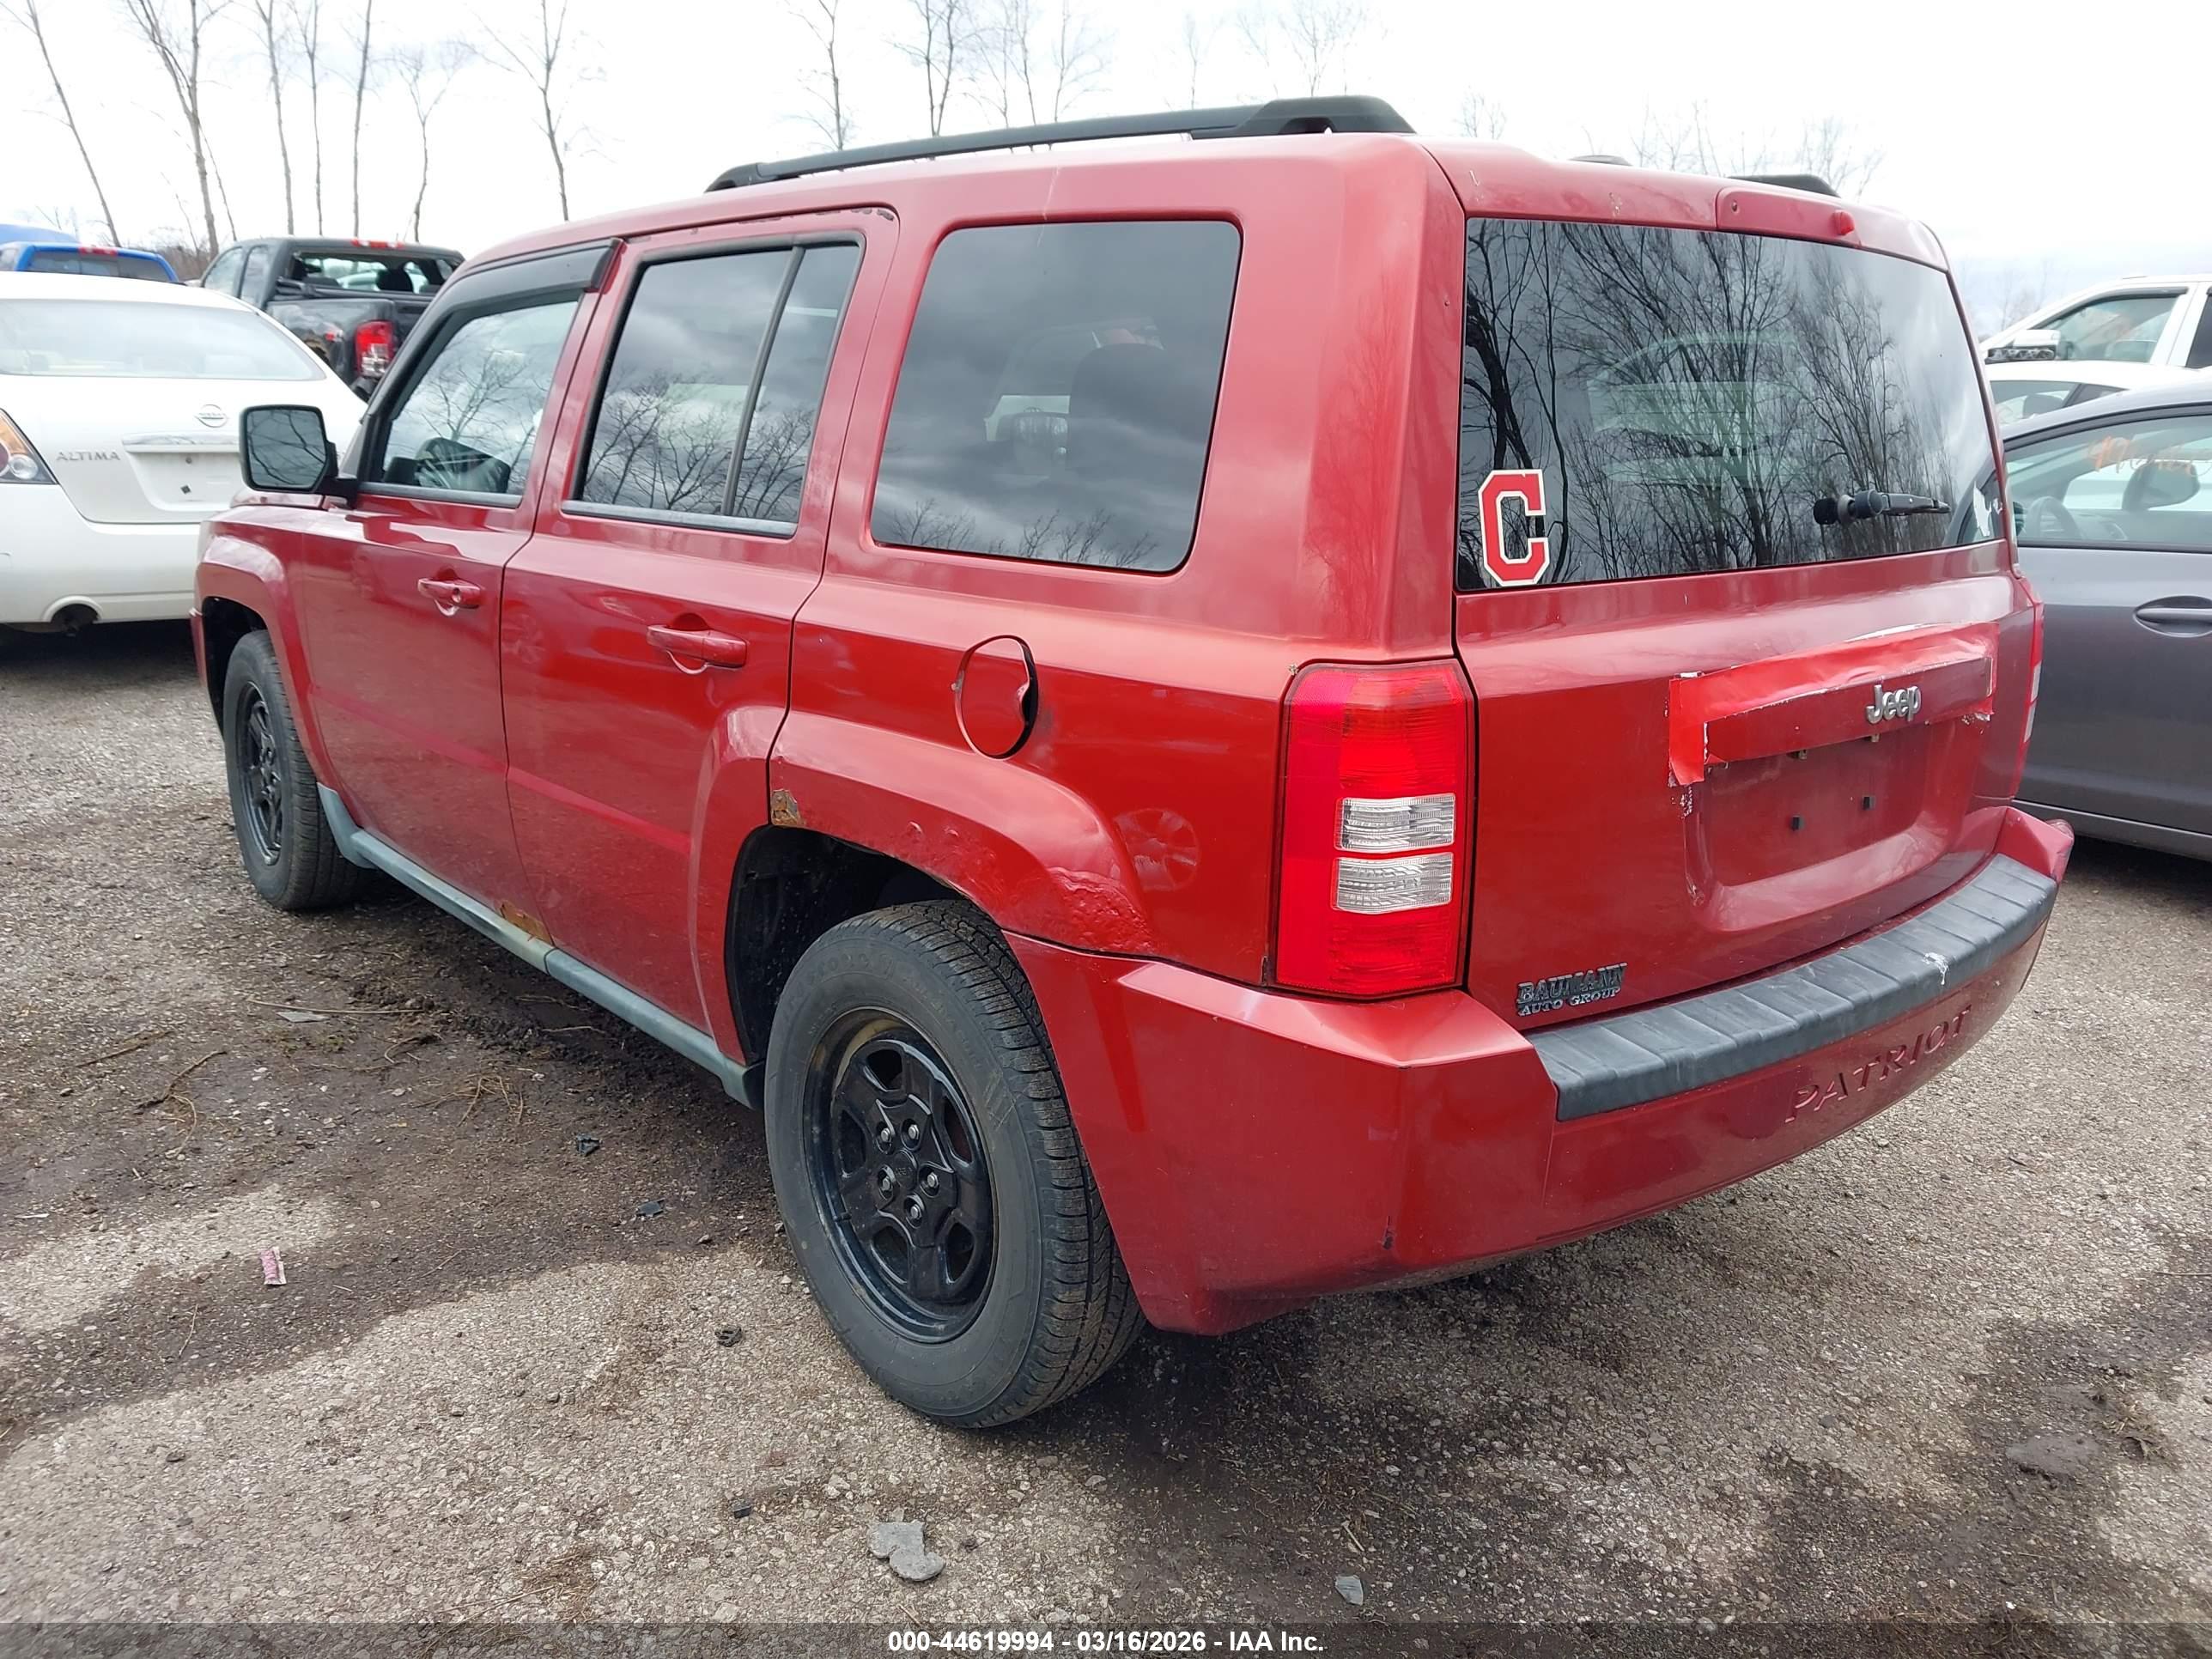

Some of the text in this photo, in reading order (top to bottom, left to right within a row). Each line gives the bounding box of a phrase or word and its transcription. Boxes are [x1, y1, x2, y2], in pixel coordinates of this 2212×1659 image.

[56, 451, 120, 461] ALTIMA
[1478, 469, 1550, 586] C
[1866, 684, 1922, 724] Jeep
[1516, 962, 1628, 1004] BAUMANN
[1518, 987, 1621, 1017] AUTO GROUP
[1784, 1005, 1972, 1123] PATRIOT
